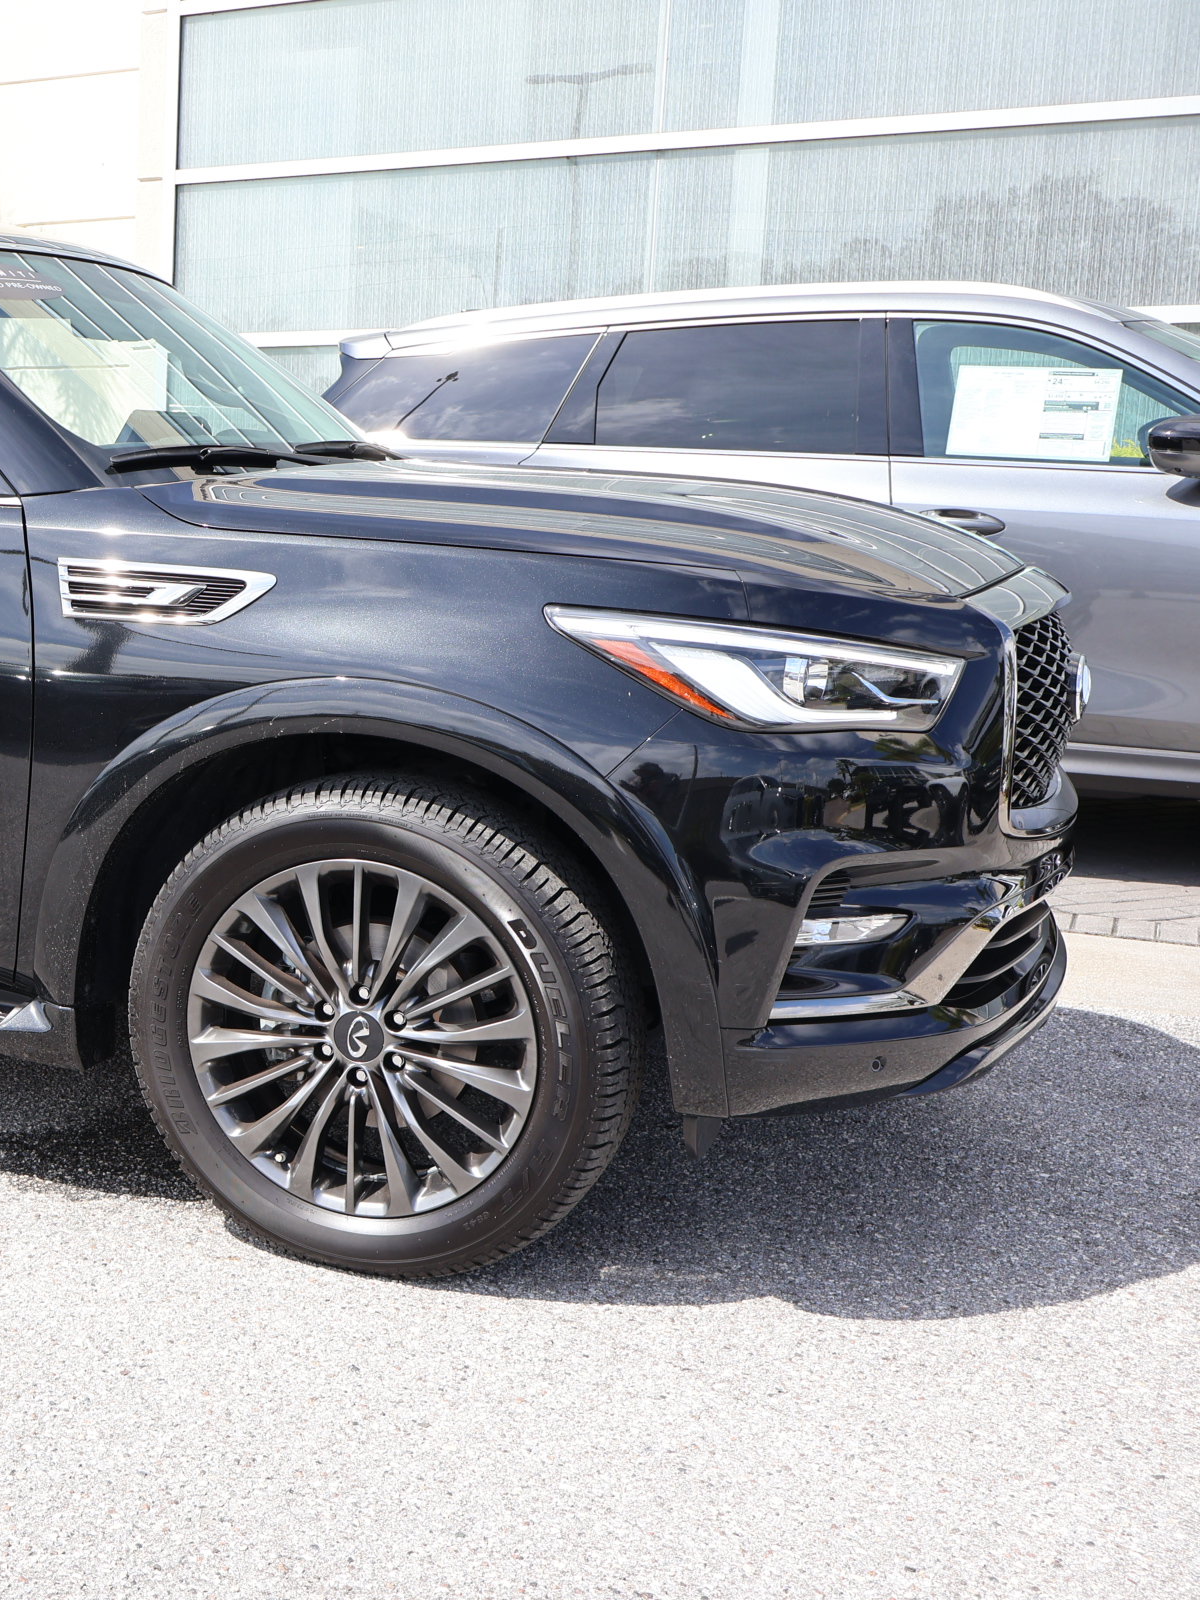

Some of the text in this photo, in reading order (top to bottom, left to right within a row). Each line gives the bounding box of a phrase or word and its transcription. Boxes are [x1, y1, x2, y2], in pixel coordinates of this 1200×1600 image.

[5, 281, 62, 292] PRE-OWNED
[150, 892, 201, 1137] BRIDGESTONE
[506, 917, 574, 1122] DUELER
